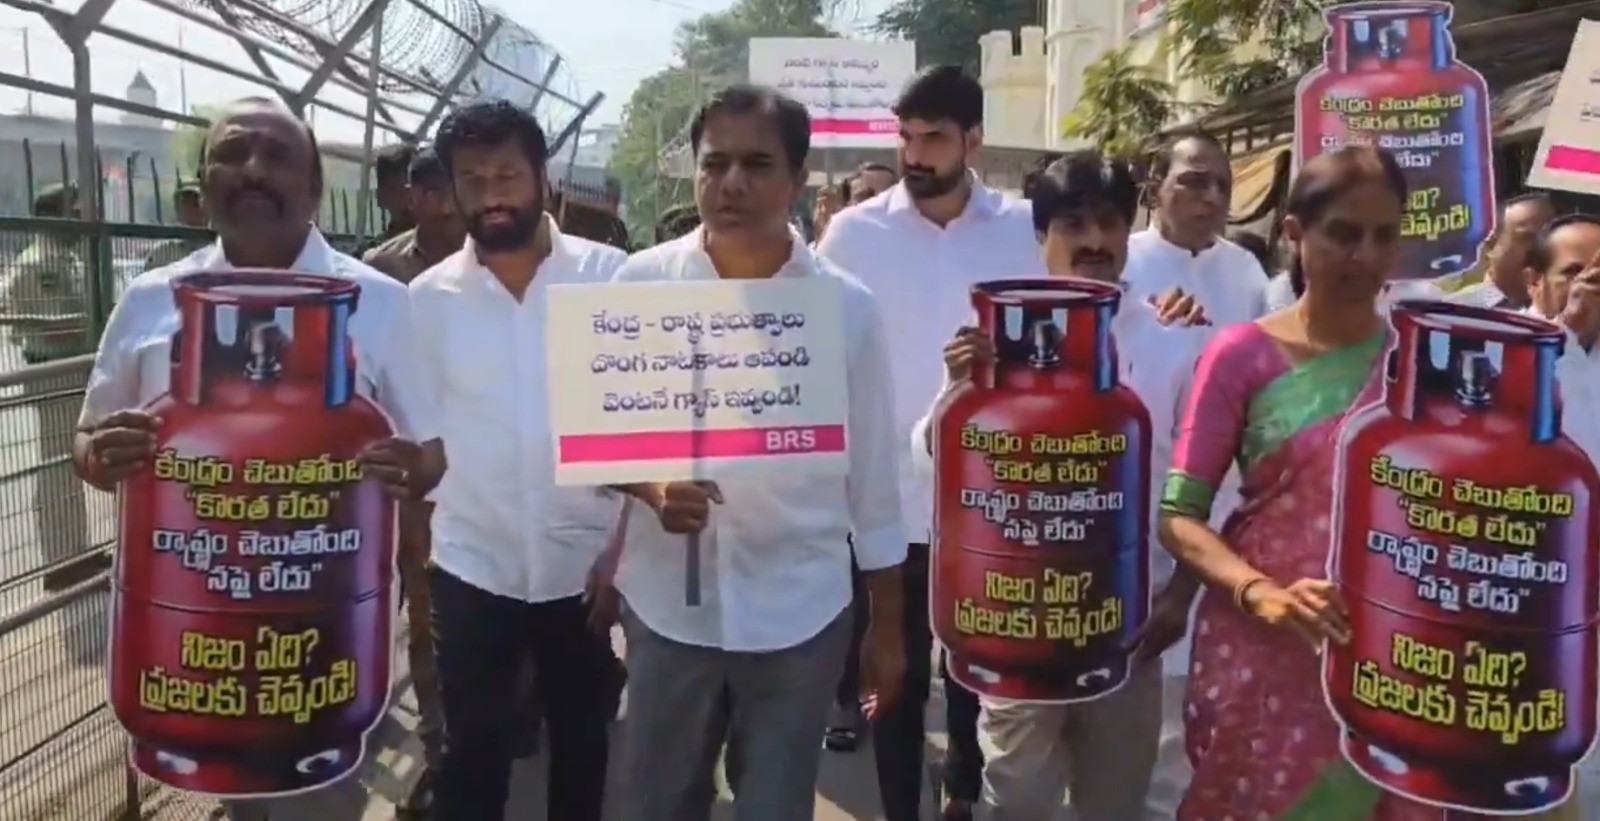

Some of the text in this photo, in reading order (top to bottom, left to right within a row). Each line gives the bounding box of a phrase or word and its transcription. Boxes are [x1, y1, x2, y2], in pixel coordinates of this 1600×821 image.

[593, 310, 641, 339] కేంద్ర
[661, 313, 704, 344] రాష్ట్ర
[710, 311, 805, 337] ప్రభుత్వాలు
[591, 353, 648, 373] దొంగ
[652, 351, 739, 371] నాటకాలు
[603, 387, 668, 411] వెంటనే
[673, 388, 720, 418] గ్యాస్
[766, 430, 816, 450] BRS
[961, 423, 1126, 454] కేంద్రం చెబుతోంది
[155, 452, 233, 486] కేంద్రం
[1371, 455, 1574, 515] కేంద్రం చెబుతోంది
[961, 488, 1124, 524] రాష్ట్రం చెబుతోంది
[153, 525, 360, 570] రాష్ట్రం చెబుతోంది
[1367, 529, 1567, 583] రాష్ట్రం చెబుతోంది
[985, 568, 1093, 603] నిజం ఏది?
[955, 597, 1122, 647] ప్రజలకు చెప్పండి!
[181, 627, 319, 669] నిజం ఏది?
[1393, 633, 1526, 688] నిజం ఏది?
[140, 660, 356, 723] ప్రజలకు చెప్పండి!
[1353, 661, 1565, 745] ప్రజలకు చెప్పండి!
